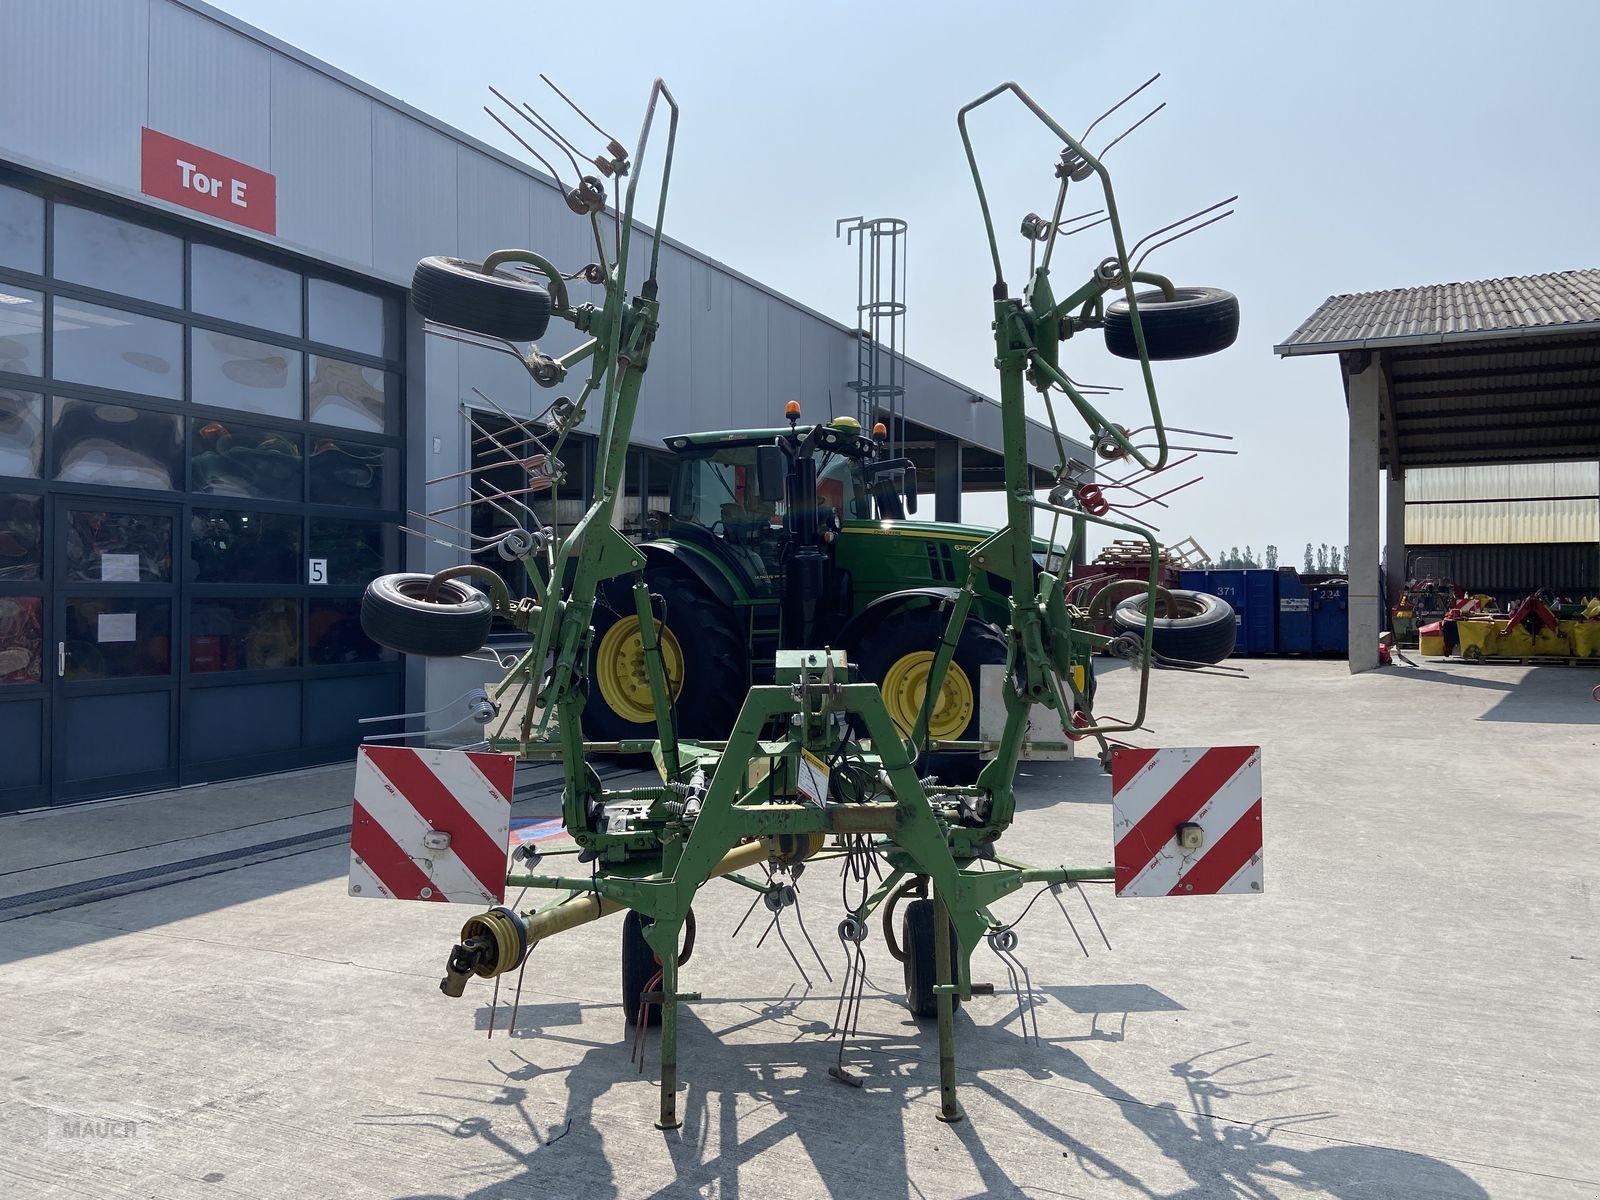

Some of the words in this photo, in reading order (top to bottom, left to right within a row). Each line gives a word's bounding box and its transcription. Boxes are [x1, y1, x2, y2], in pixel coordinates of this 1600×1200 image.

[176, 159, 222, 198] Tor
[231, 178, 248, 208] E
[312, 562, 323, 582] 5
[1217, 586, 1235, 596] 371
